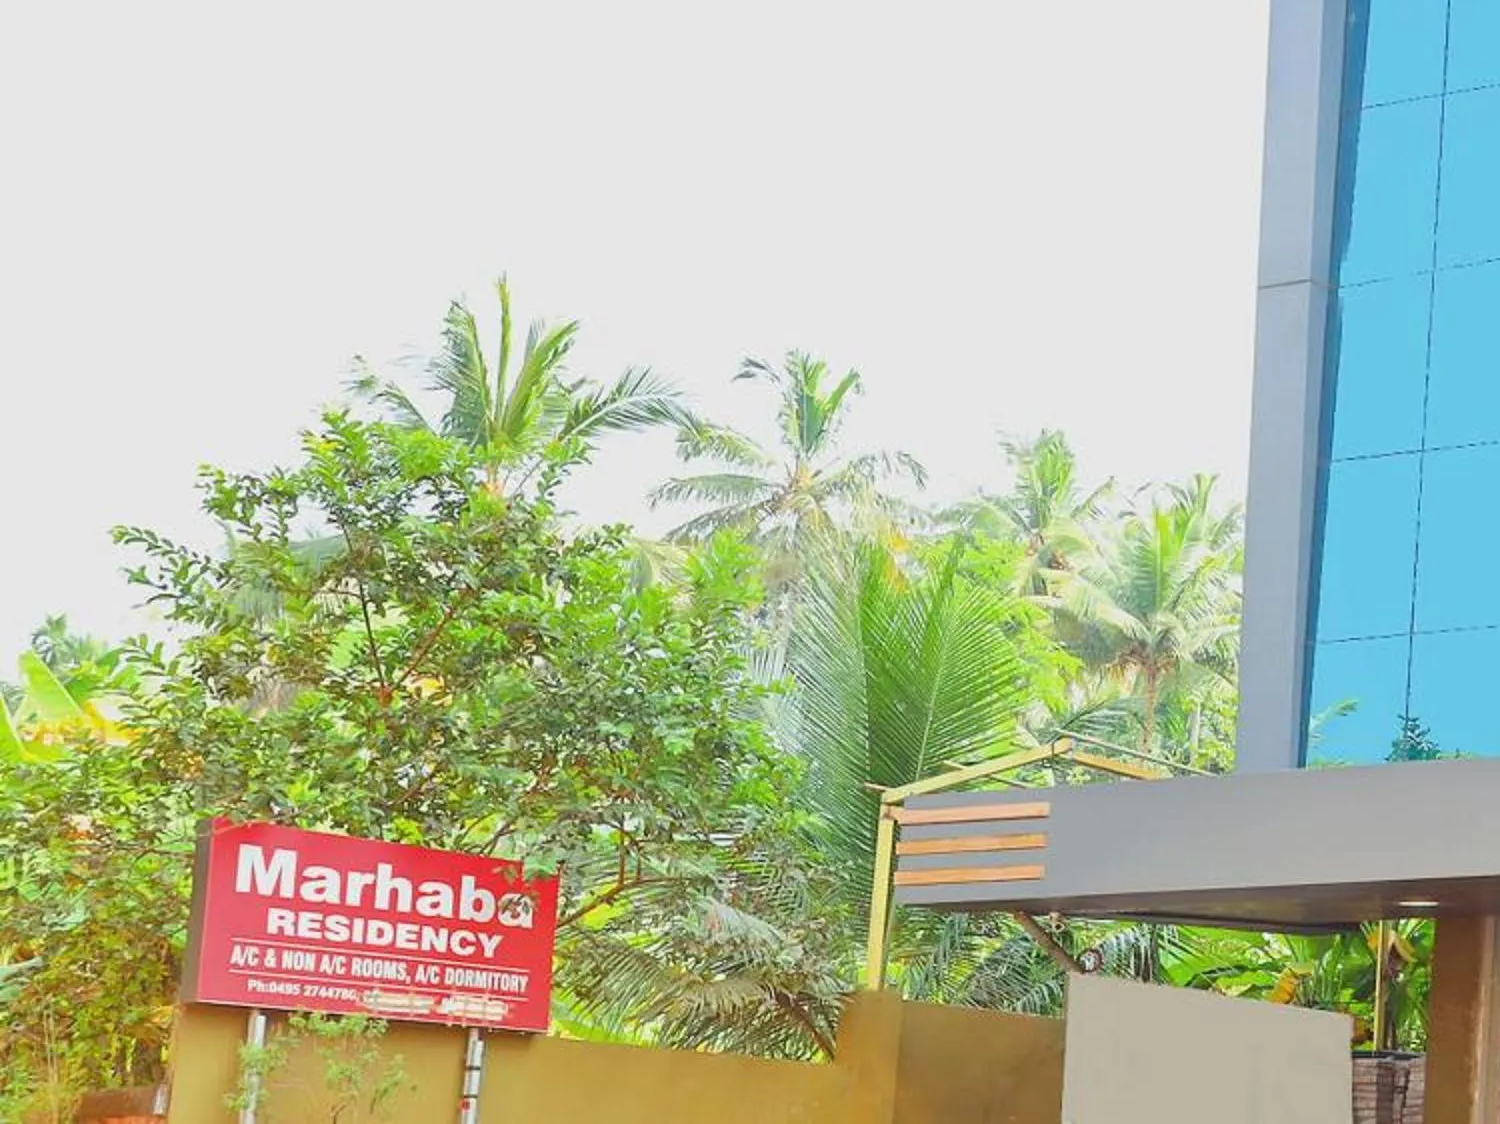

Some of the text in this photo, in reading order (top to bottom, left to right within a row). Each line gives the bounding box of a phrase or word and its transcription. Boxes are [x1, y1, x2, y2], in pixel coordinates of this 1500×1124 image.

[235, 843, 533, 929] Marhaba
[266, 907, 504, 959] RESIDENCY
[229, 944, 529, 994] A/C & NON A/C ROOMS, A/C DORMITORY
